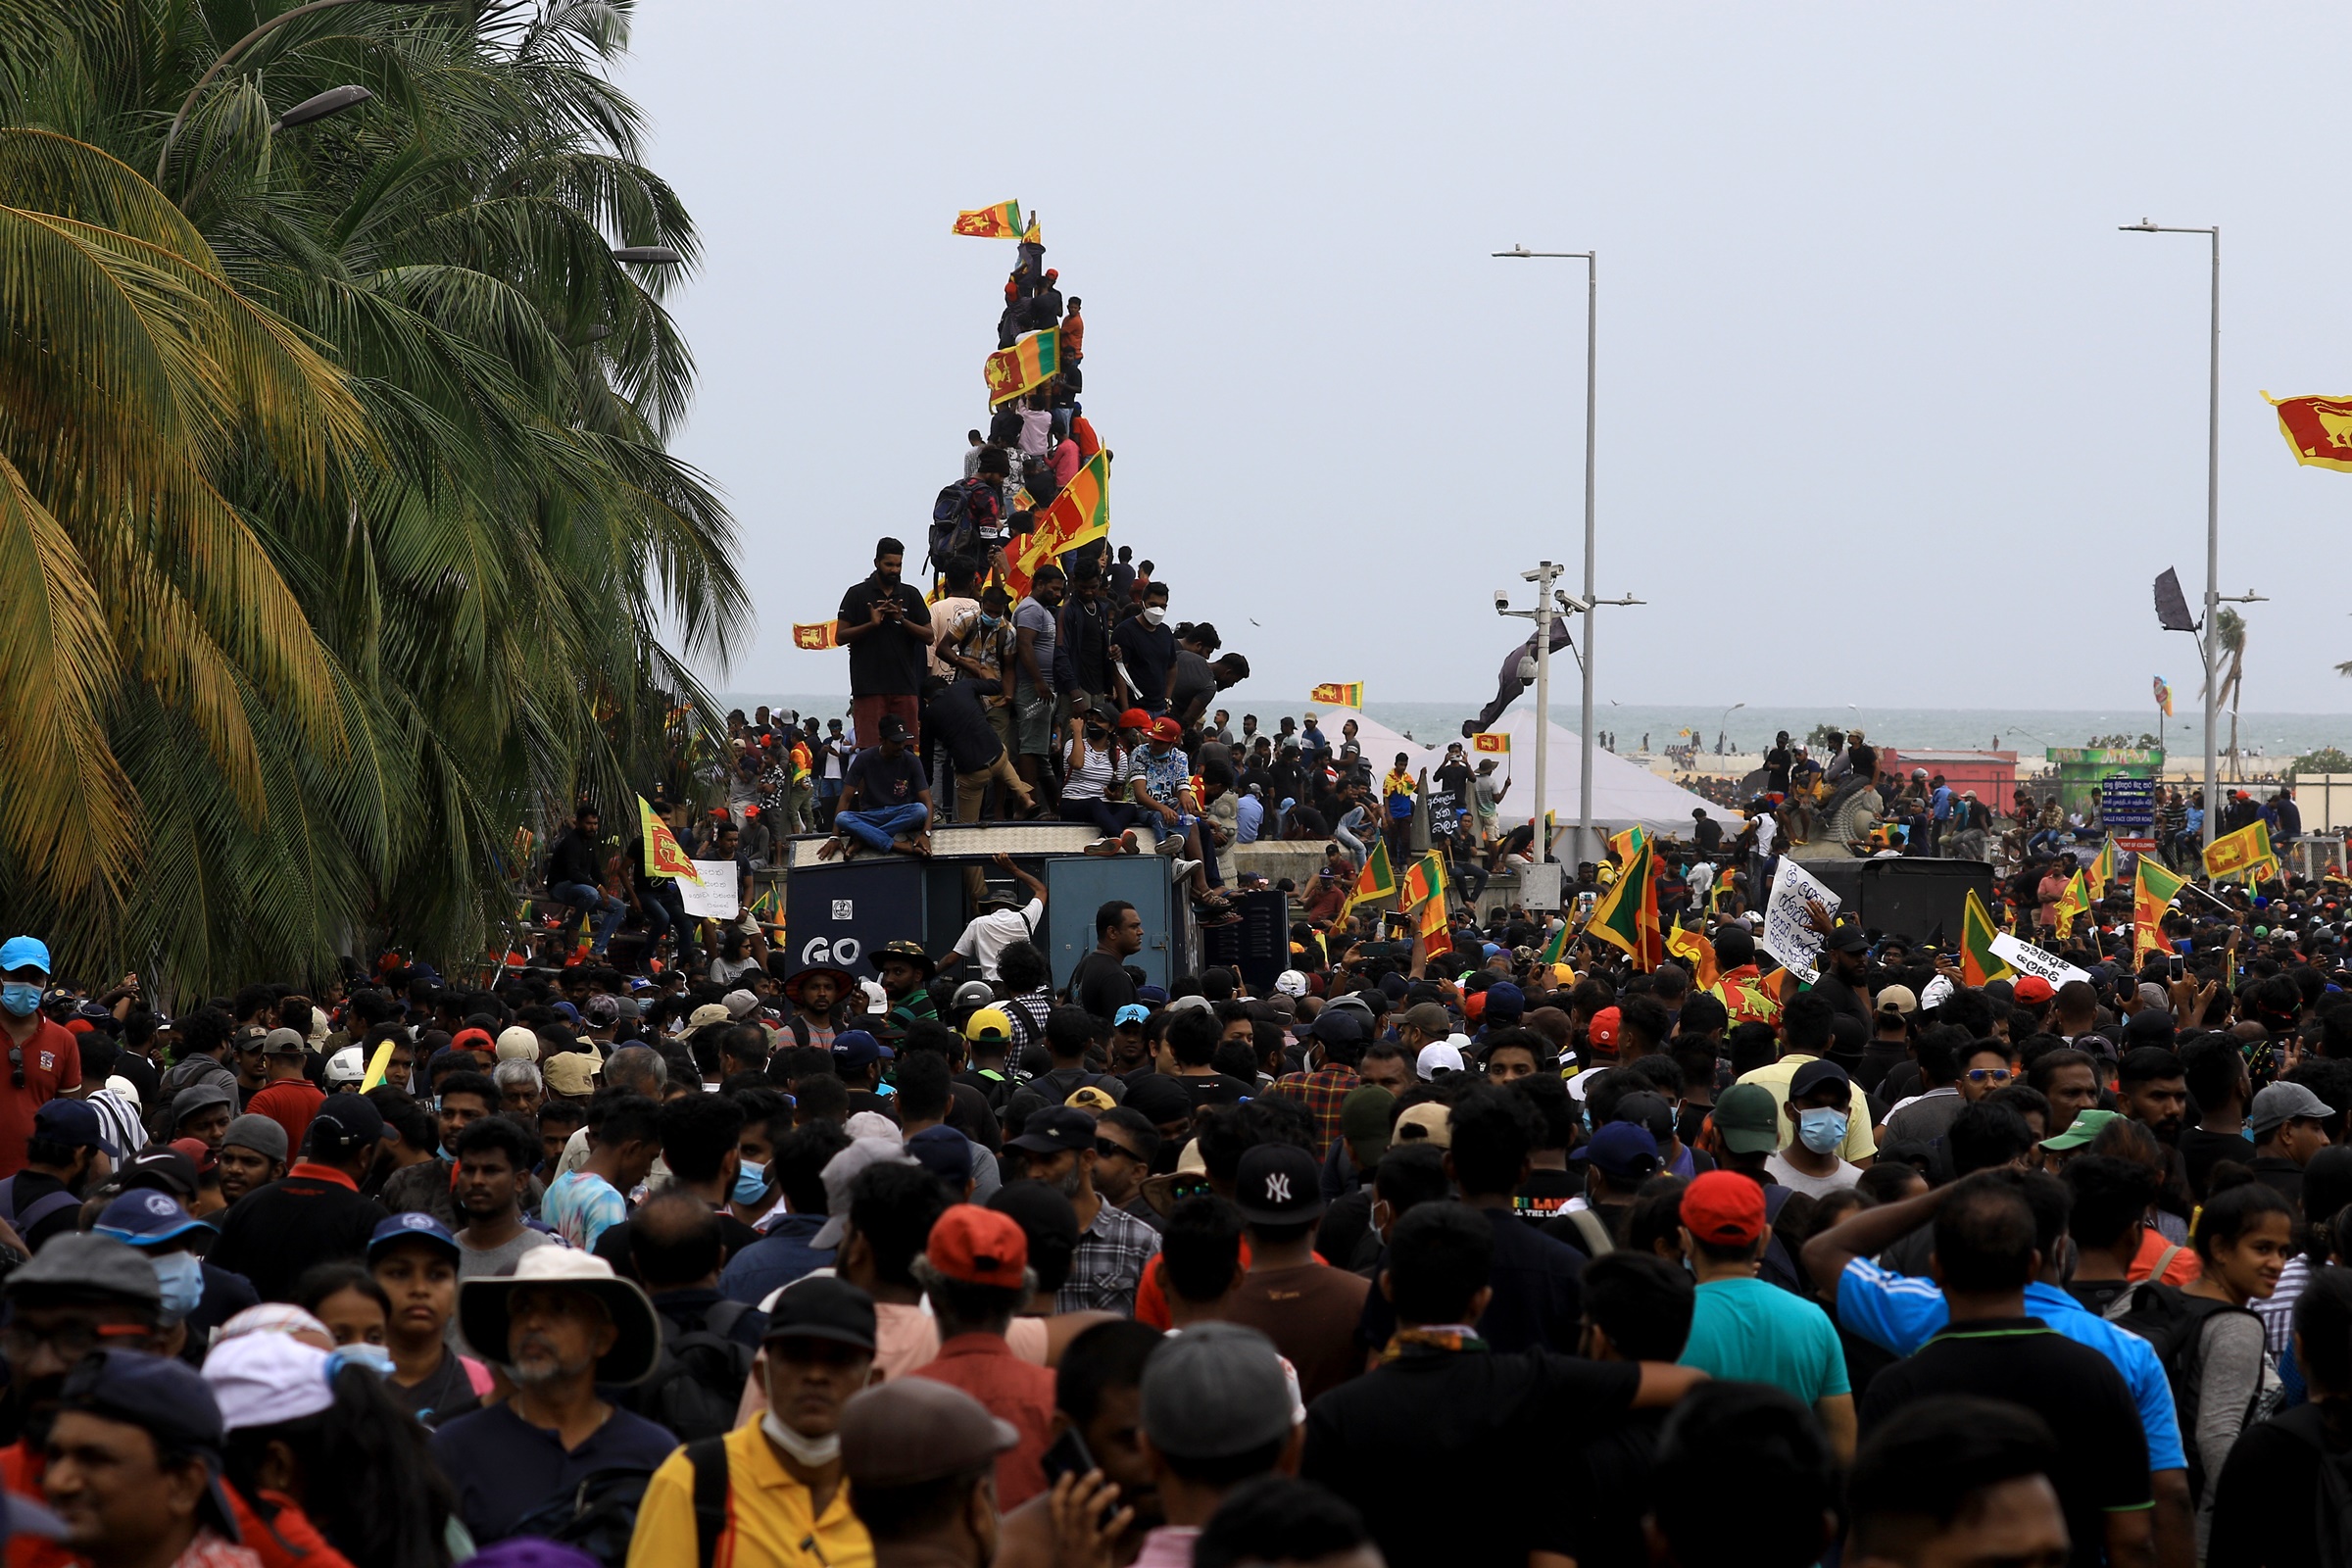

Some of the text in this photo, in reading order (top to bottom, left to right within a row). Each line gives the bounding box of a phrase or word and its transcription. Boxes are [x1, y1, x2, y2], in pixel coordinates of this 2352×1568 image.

[802, 936, 862, 966] GO
[2016, 954, 2060, 983] ඉන්ධන
[1265, 1172, 1293, 1203] NY
[1512, 1196, 1570, 1210] RI LAN
[1525, 1208, 1544, 1217] THE
